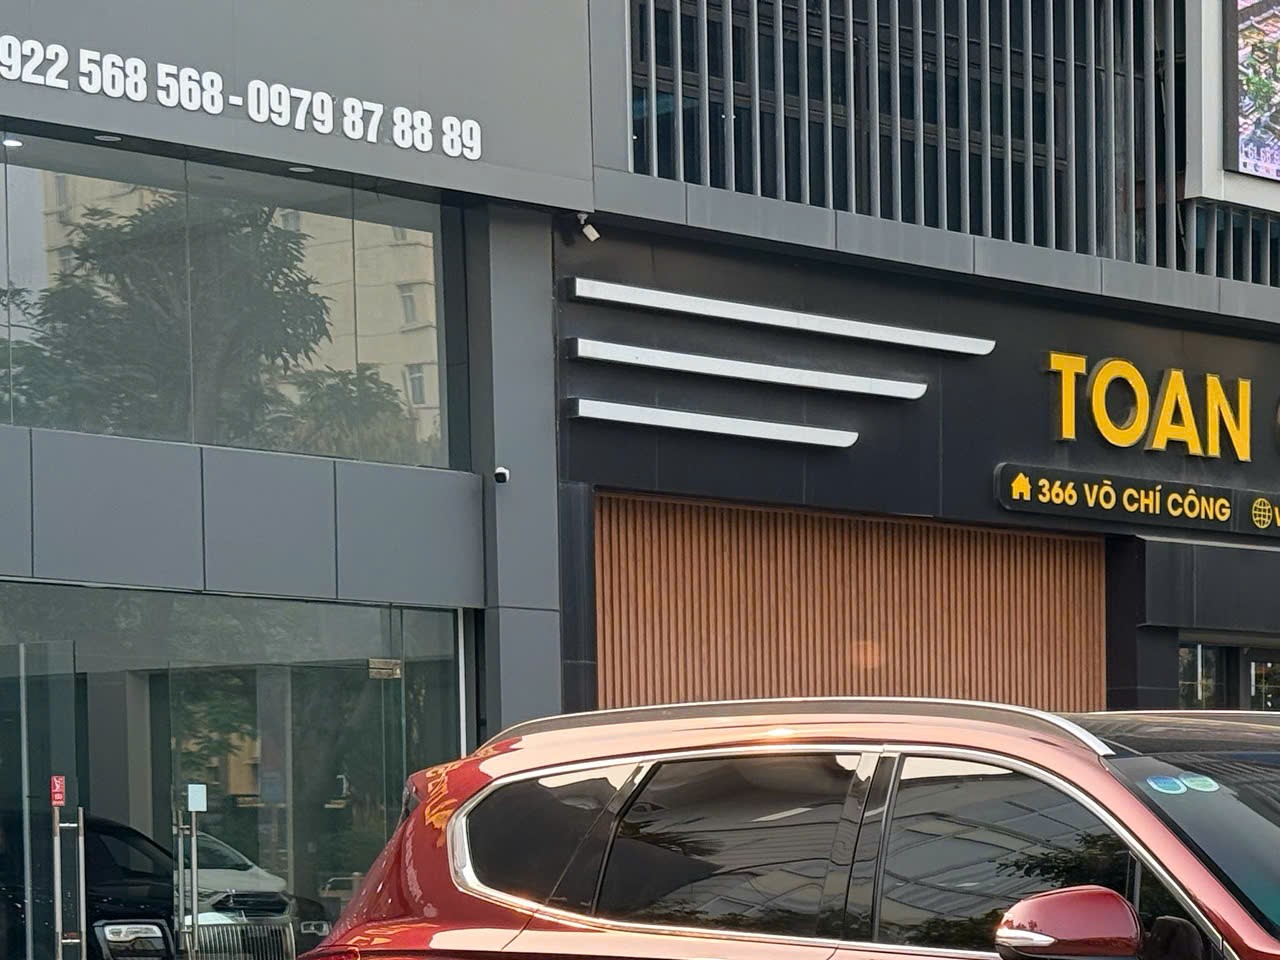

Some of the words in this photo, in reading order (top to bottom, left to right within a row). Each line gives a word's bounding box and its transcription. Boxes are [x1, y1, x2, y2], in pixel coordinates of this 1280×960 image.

[78, 48, 149, 102] 568
[342, 97, 384, 144] 87
[392, 106, 433, 153] 88
[441, 116, 482, 161] 89
[1048, 350, 1253, 463] TOAN
[1038, 478, 1078, 506] 366
[1122, 484, 1162, 515] CHÍ
[1166, 488, 1232, 522] CÔNG
